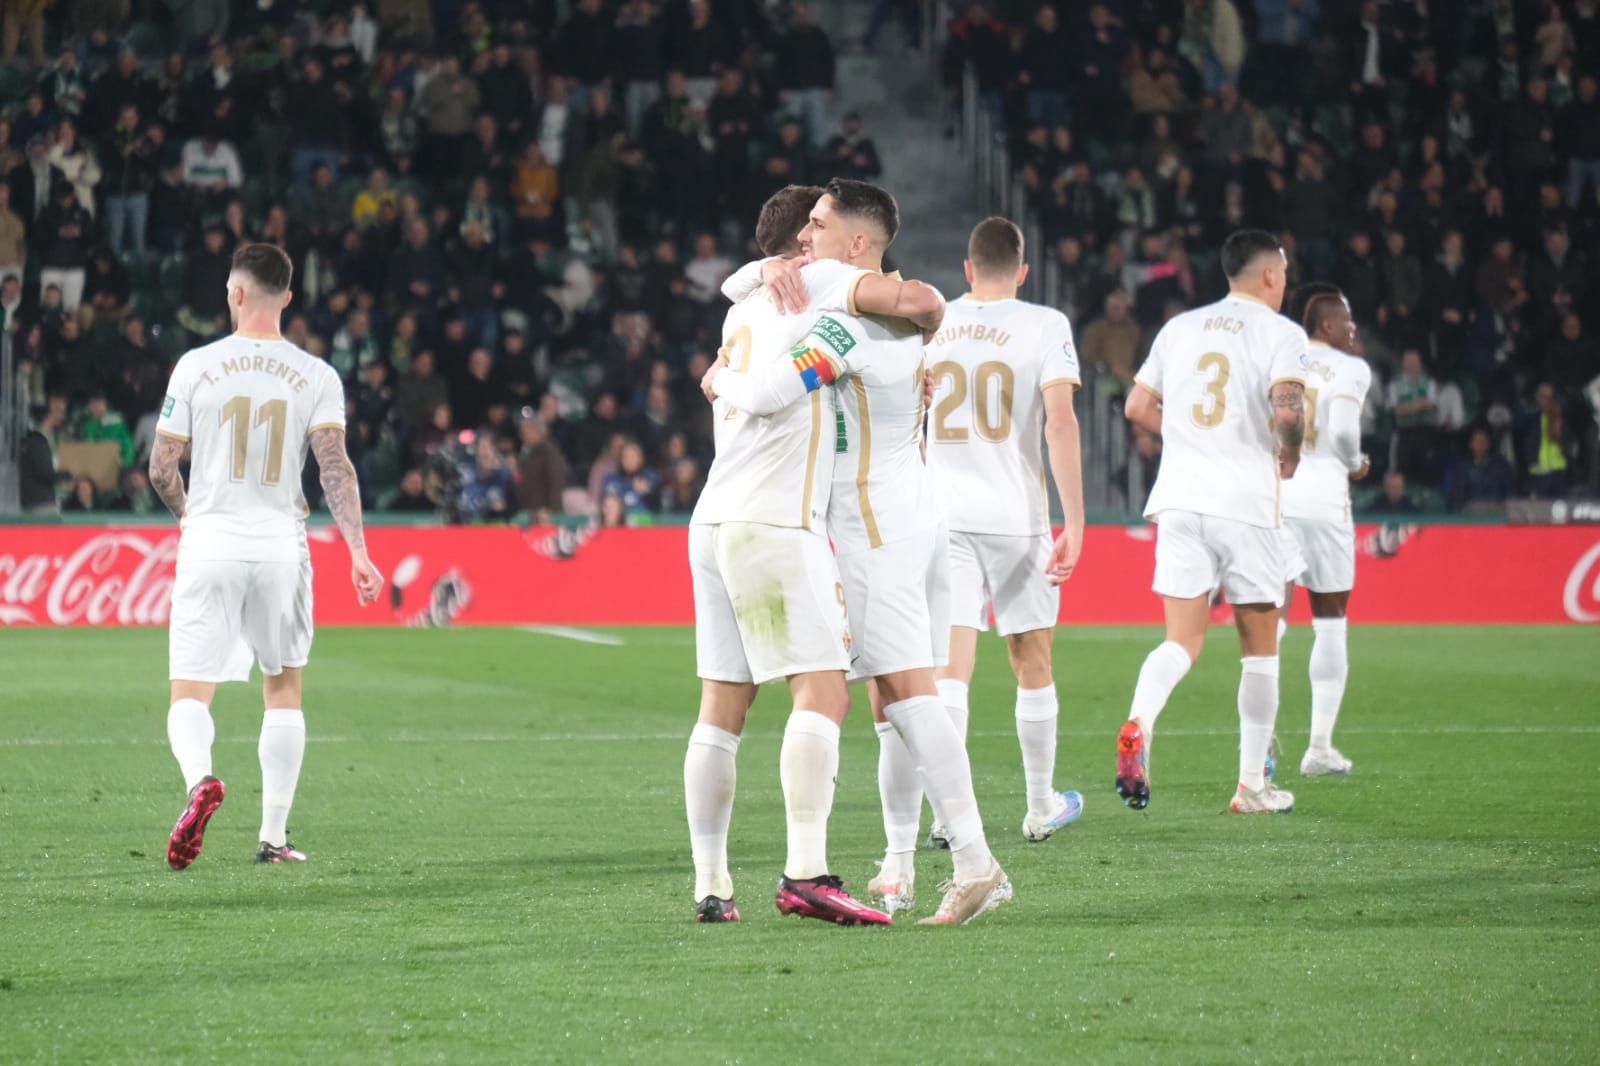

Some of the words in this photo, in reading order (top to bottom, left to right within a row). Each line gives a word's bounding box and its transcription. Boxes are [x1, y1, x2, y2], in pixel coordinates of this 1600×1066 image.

[201, 370, 220, 385] T.
[221, 355, 309, 393] MORENTE
[934, 324, 1011, 346] GUMBAU
[932, 360, 1015, 444] 20
[1190, 351, 1230, 430] 3
[218, 395, 289, 487] 11
